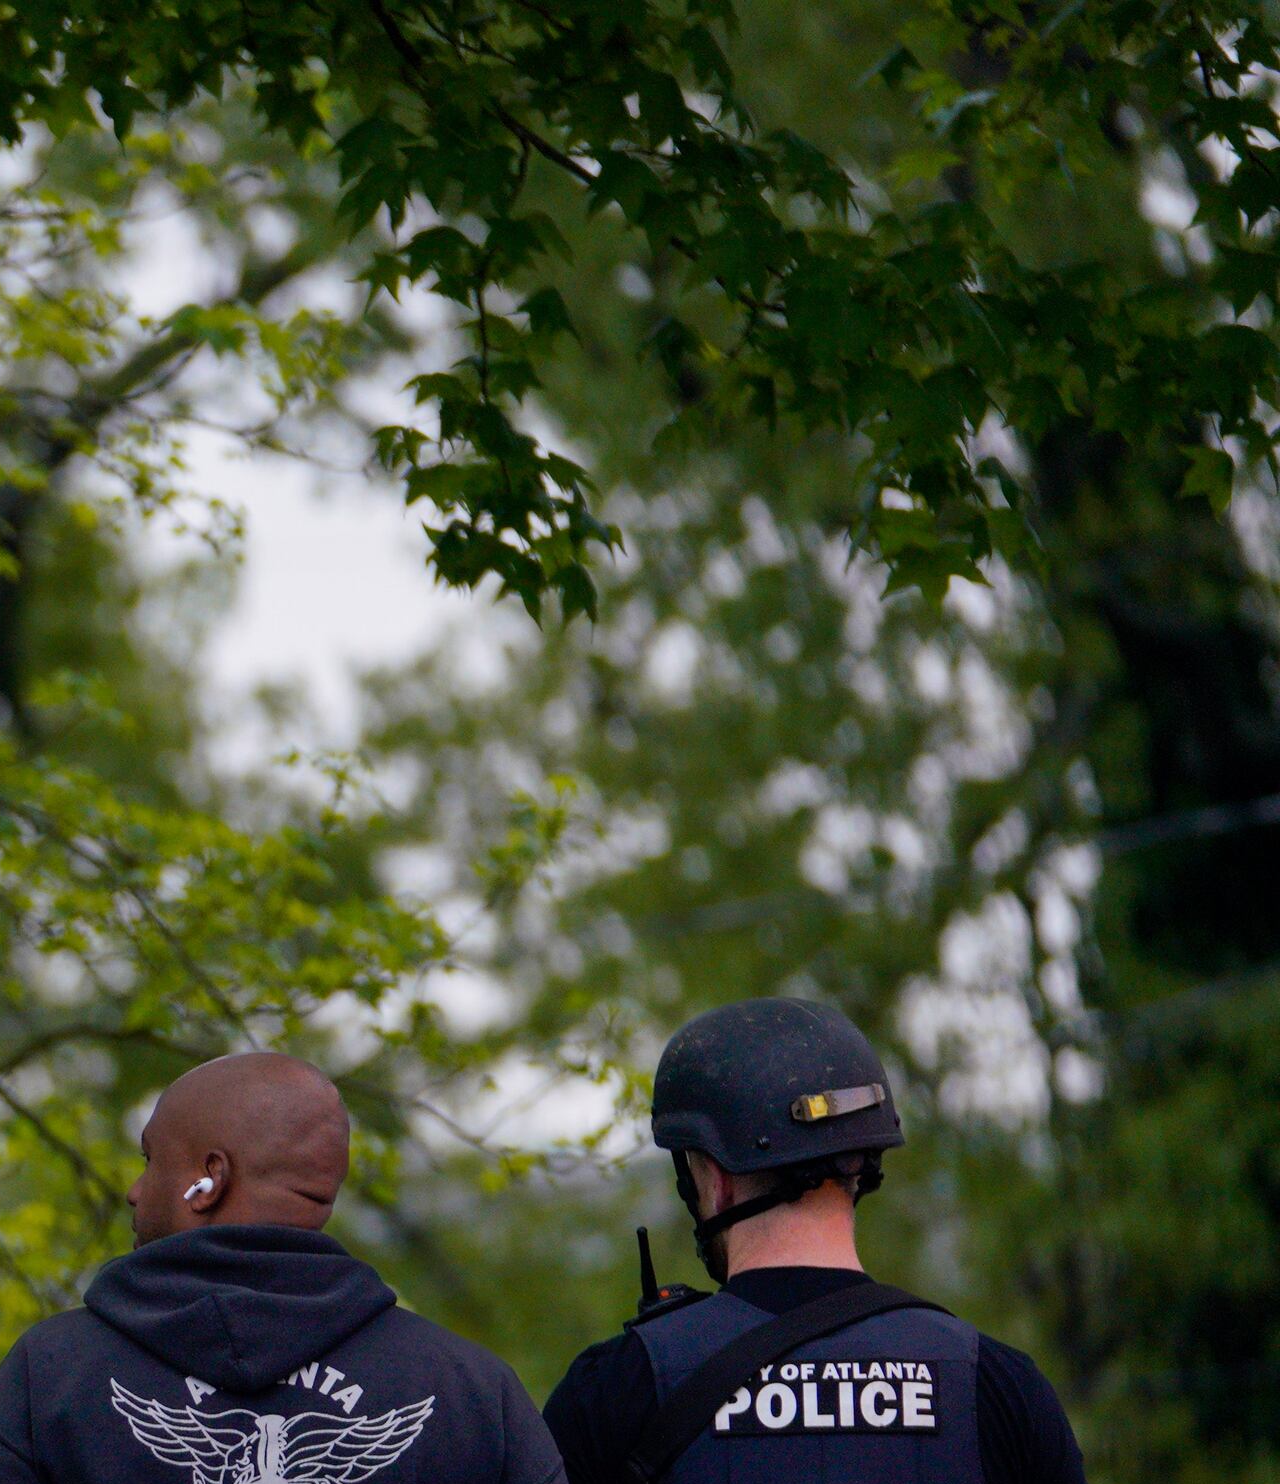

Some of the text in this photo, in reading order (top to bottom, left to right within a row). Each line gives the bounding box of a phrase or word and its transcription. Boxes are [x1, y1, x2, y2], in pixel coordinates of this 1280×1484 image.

[184, 1361, 365, 1415] ANTA
[779, 1363, 816, 1381] OF
[822, 1361, 933, 1380] ATLANTA
[714, 1381, 936, 1430] POLICE
